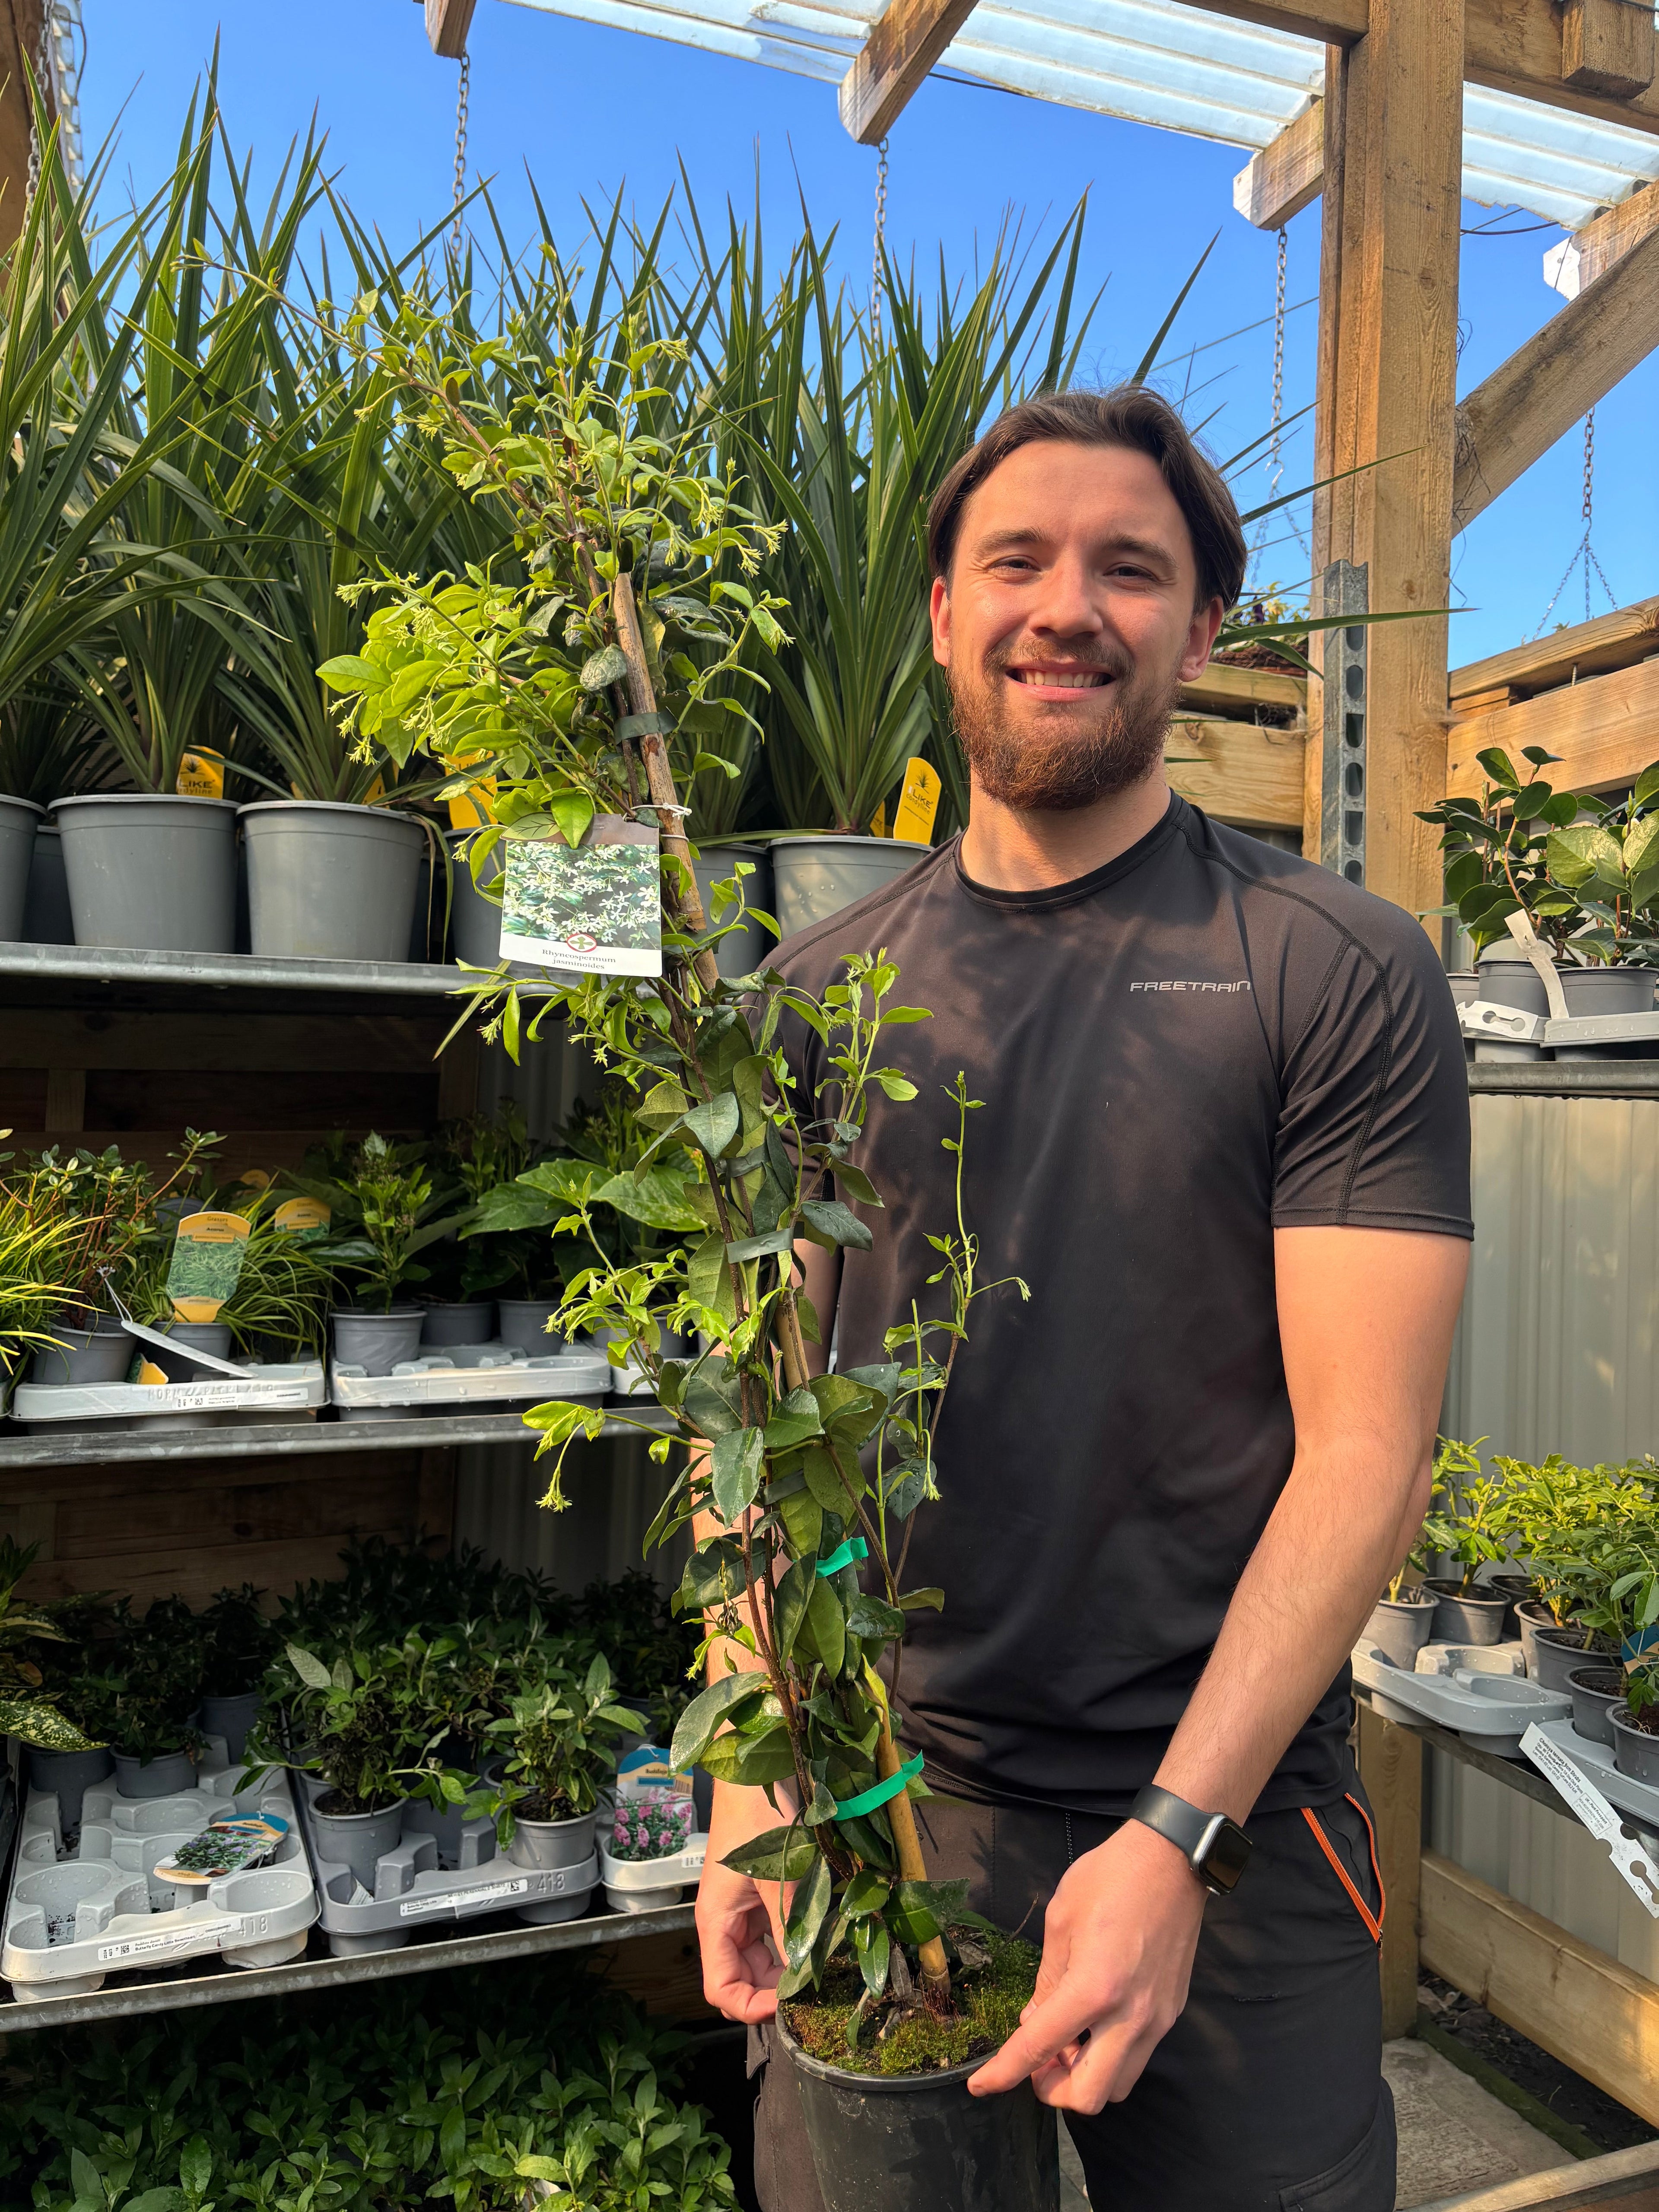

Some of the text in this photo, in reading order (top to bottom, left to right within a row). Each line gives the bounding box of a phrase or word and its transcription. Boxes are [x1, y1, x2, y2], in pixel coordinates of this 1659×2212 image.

[542, 949, 616, 963] Rhyncospermum
[553, 958, 604, 969] jasminoides
[1130, 980, 1251, 993] FREETRAIN
[537, 1872, 565, 1893] 418
[238, 1915, 268, 1937] 418
